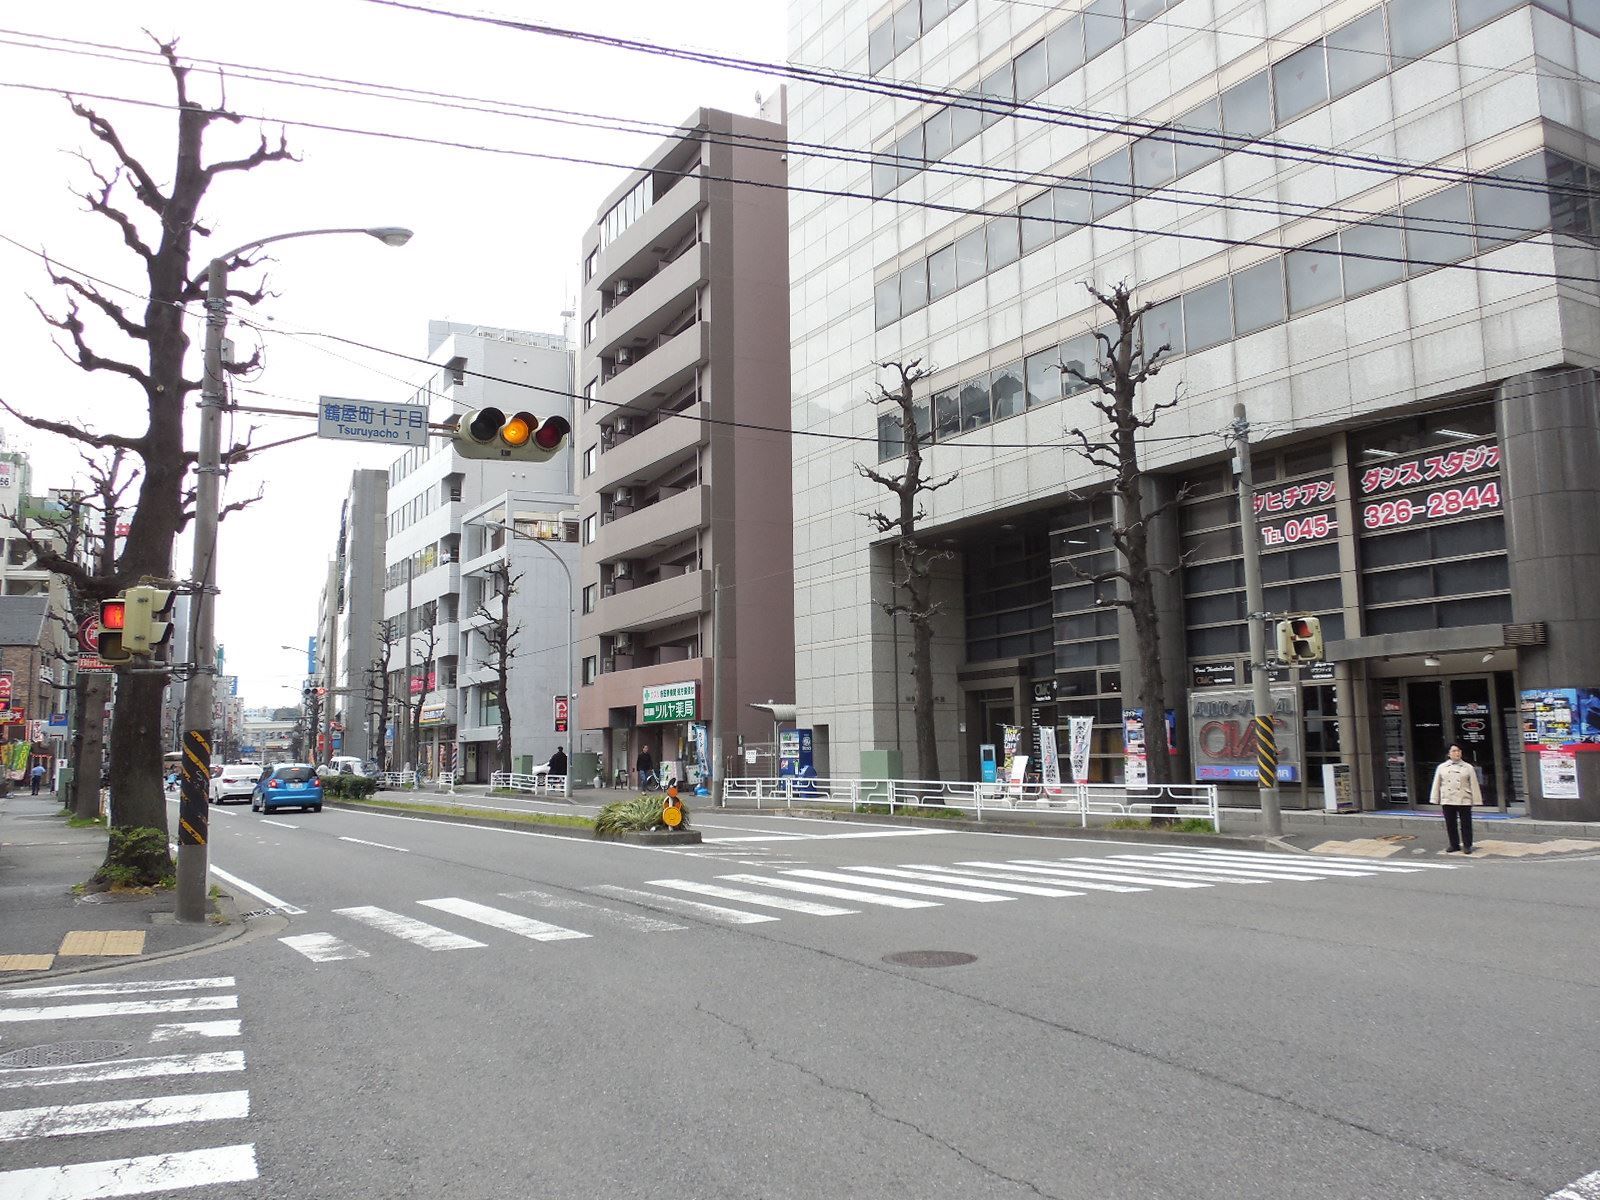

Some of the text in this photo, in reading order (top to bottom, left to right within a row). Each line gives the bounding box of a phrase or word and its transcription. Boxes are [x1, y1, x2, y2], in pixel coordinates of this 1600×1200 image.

[337, 424, 411, 439] Tsuruyacho 1
[1361, 462, 1423, 493] ダンス
[1363, 482, 1499, 529] 326-2844
[1262, 526, 1285, 546] TEL
[655, 700, 694, 719] ツルヤ薬局
